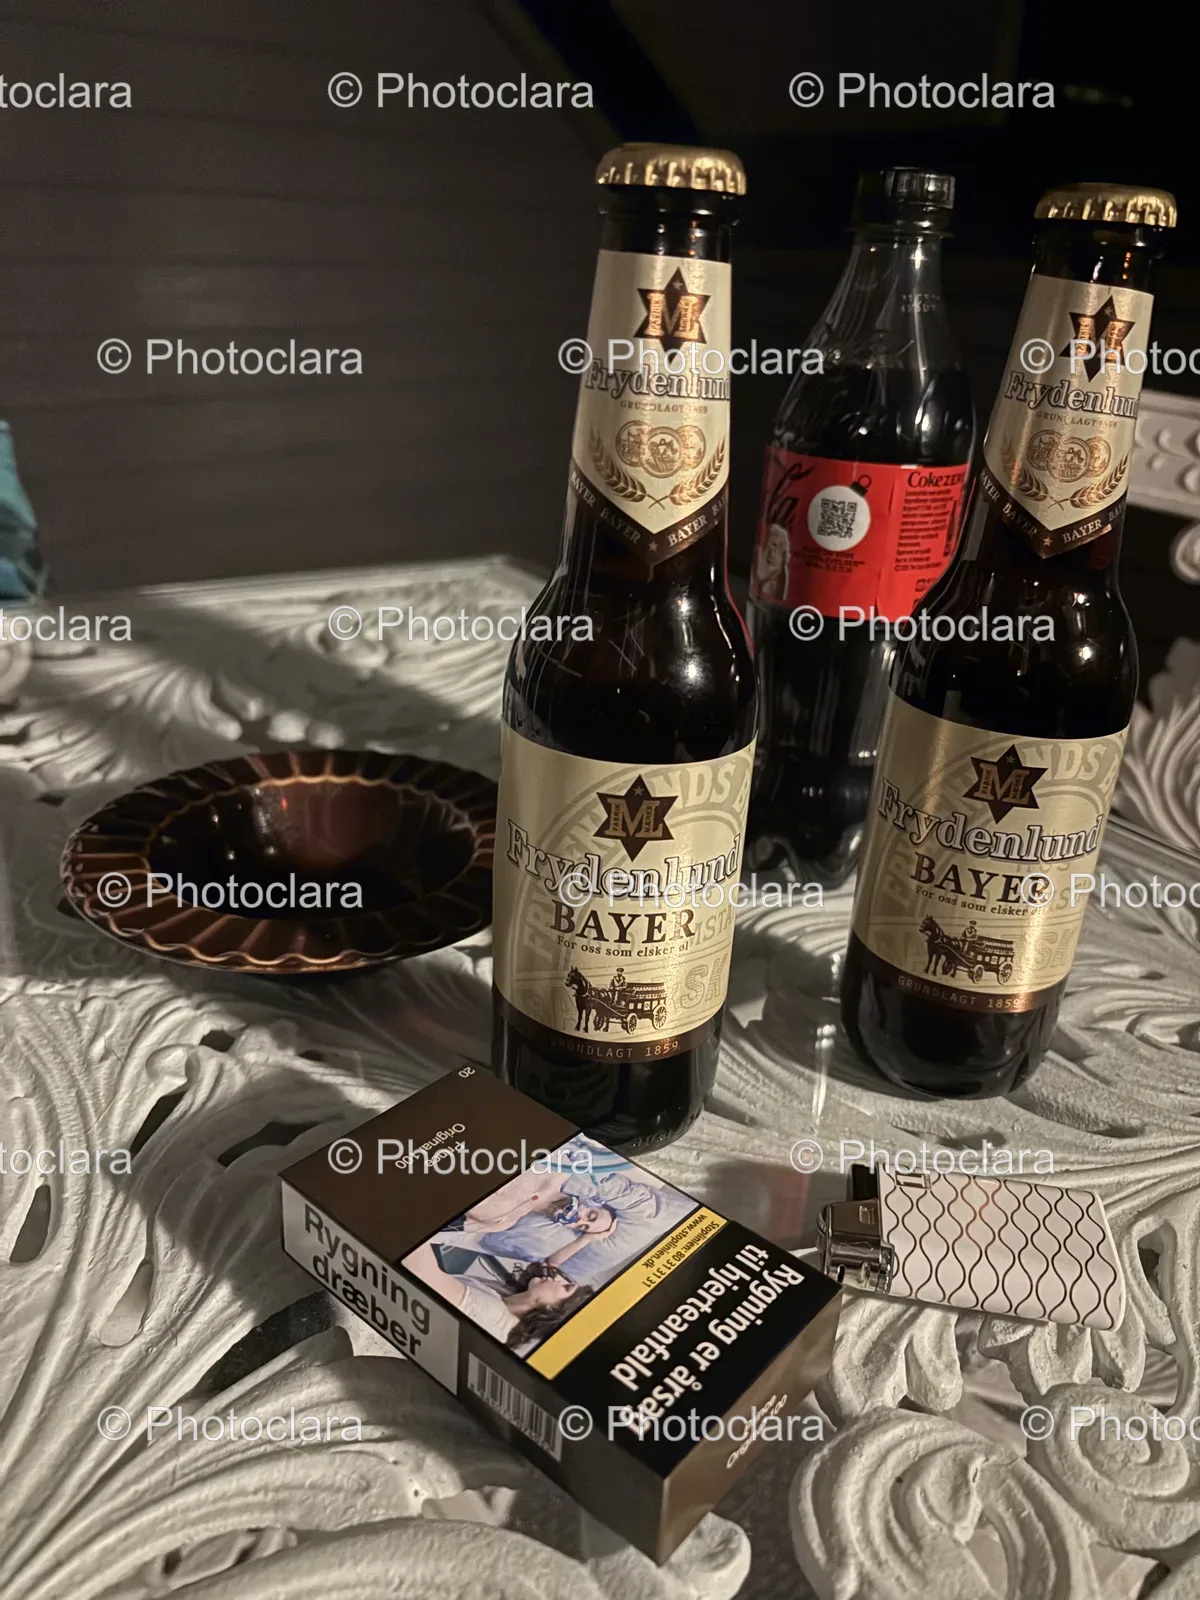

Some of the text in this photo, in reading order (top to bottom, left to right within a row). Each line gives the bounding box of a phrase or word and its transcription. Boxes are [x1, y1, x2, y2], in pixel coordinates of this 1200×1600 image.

[1004, 371, 1142, 419] Frydenlun
[570, 471, 642, 544] BAYER BAYER
[666, 514, 708, 547] BAYER
[1002, 502, 1038, 538] BAYER
[1062, 518, 1103, 544] BAYER
[877, 776, 1104, 863] Frydenlund
[507, 818, 741, 898] Frydenlund
[910, 851, 1050, 905] BAYER
[550, 899, 695, 944] BAYER
[915, 885, 935, 898] For
[938, 894, 958, 906] oss
[961, 902, 986, 912] som
[990, 905, 1028, 917] elsker
[557, 935, 577, 950] For
[581, 944, 601, 954] oss
[605, 948, 632, 957] som
[637, 946, 674, 957] elsker
[898, 976, 1021, 1009] GRUNDLAGT 1859
[458, 1067, 476, 1078] 20
[645, 1041, 680, 1057] 1859
[641, 1214, 708, 1269] www.stoplinien.dk
[642, 1220, 720, 1288] Stoplinien: 80 31 31 31
[304, 1203, 431, 1336] Rygning
[313, 1254, 422, 1356] dræber
[610, 1244, 769, 1391] til hjerteanfald
[707, 1264, 806, 1345] Rygning
[689, 1342, 721, 1371] er
[619, 1364, 703, 1436] årsag
